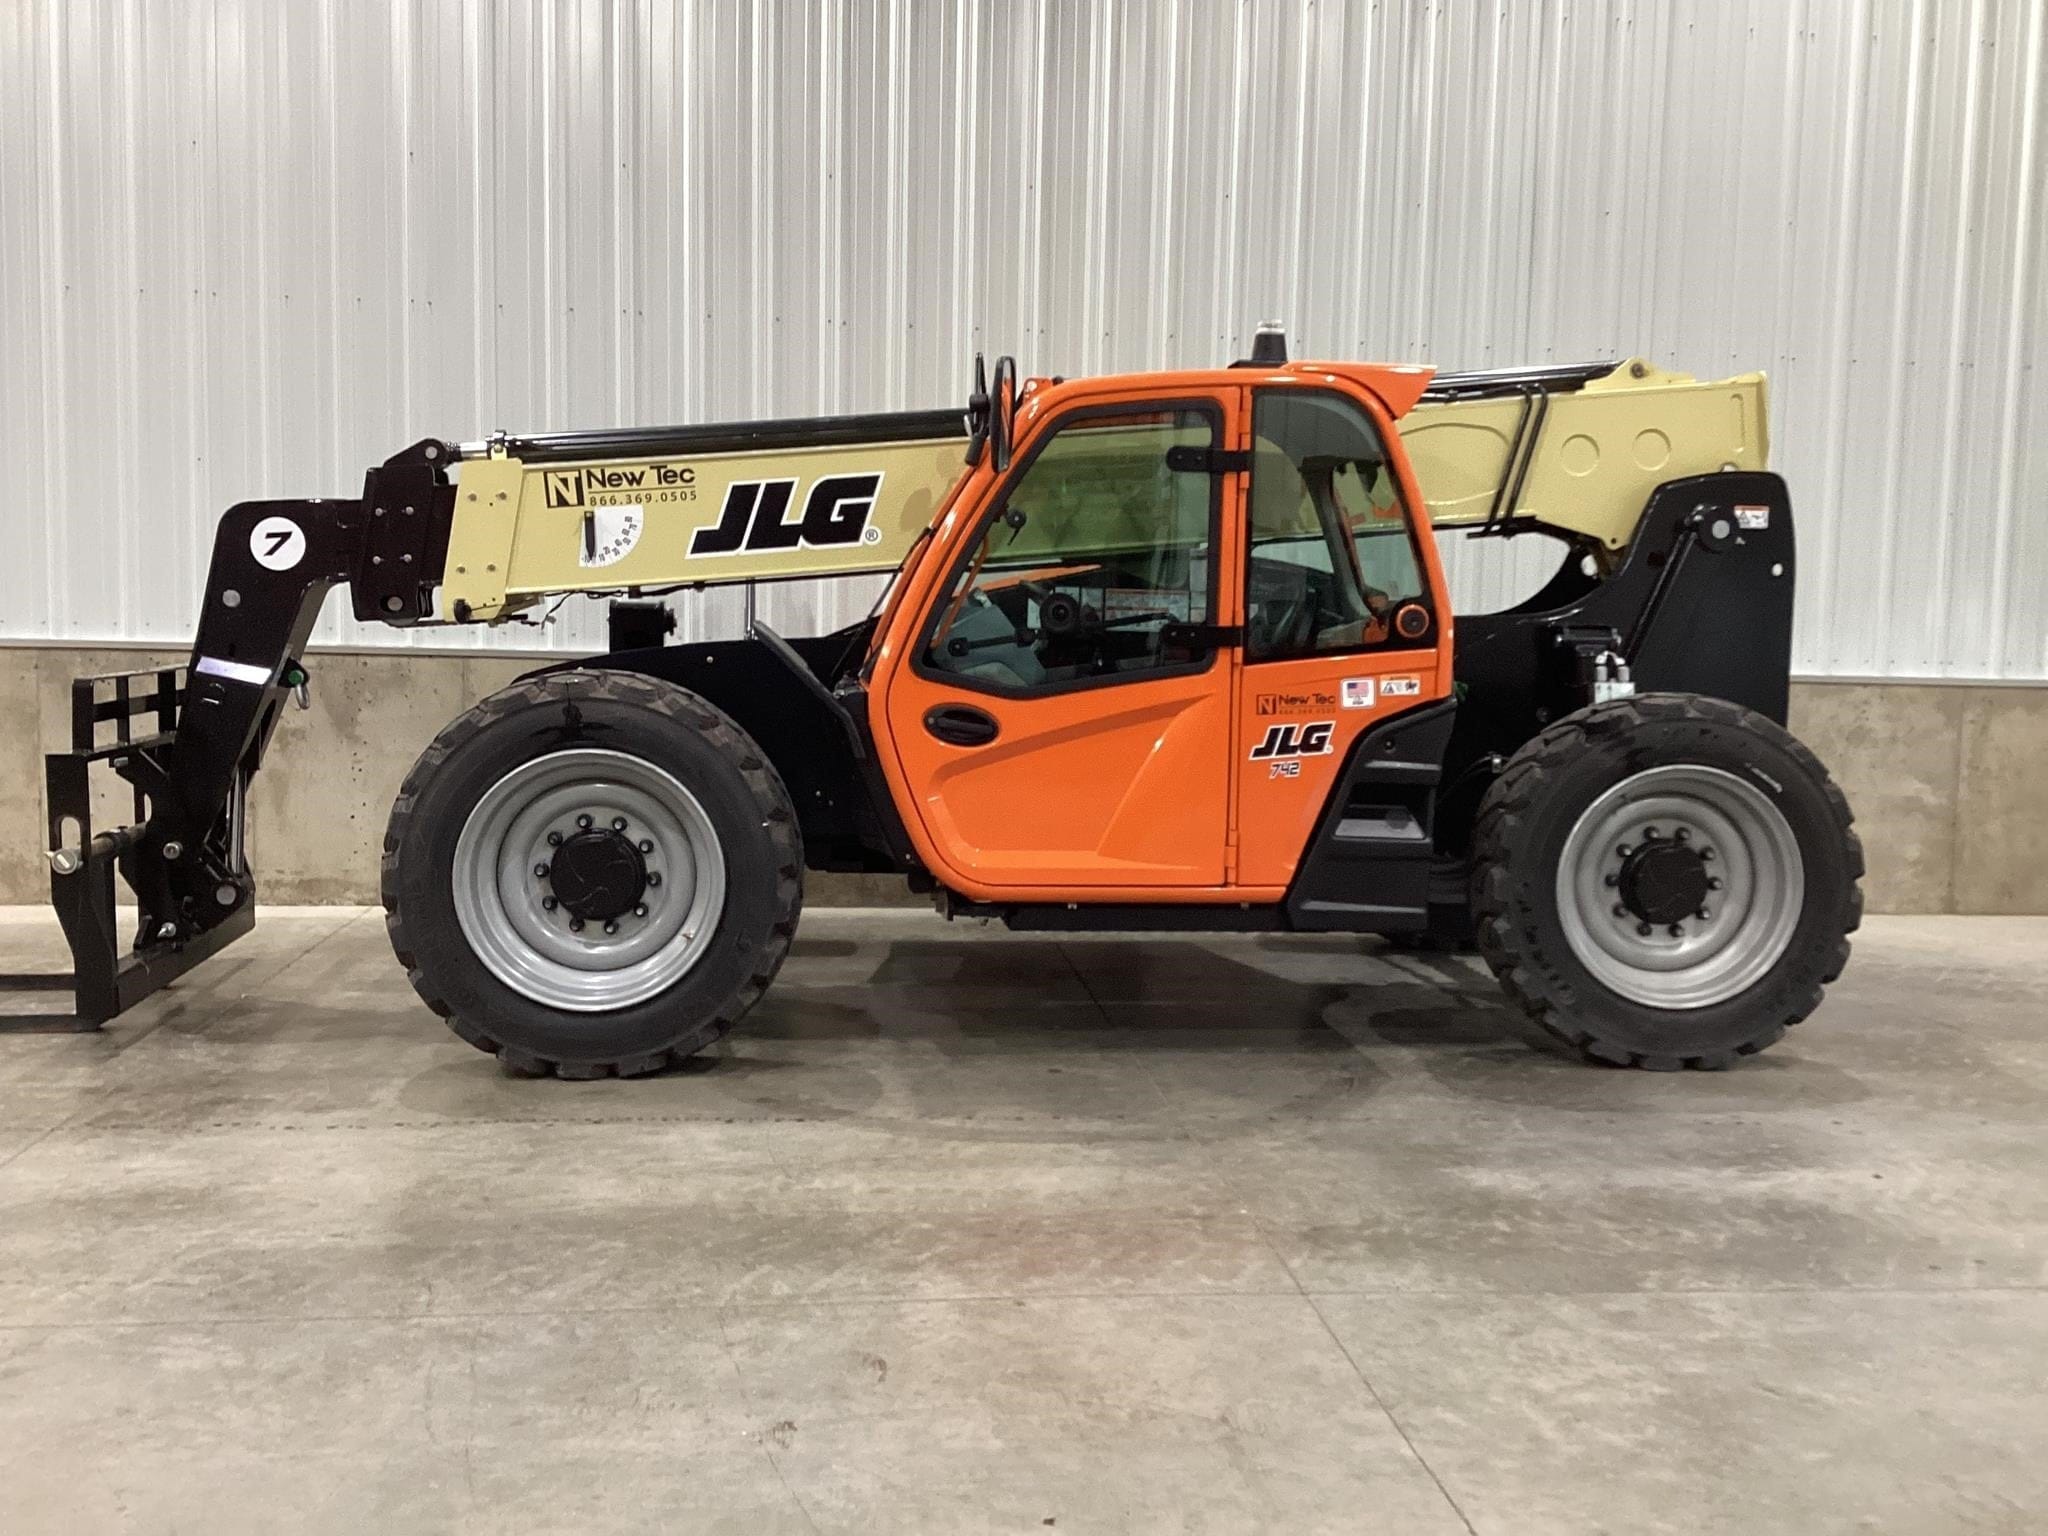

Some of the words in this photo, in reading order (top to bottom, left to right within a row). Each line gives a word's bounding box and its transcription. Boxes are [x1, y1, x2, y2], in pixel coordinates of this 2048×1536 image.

[586, 469, 645, 489] New
[650, 465, 696, 486] Tec
[590, 490, 697, 507] 866.369.0505
[689, 474, 881, 555] JLG
[263, 531, 293, 557] 7
[1279, 694, 1310, 706] New
[1312, 693, 1336, 705] Tec
[1251, 723, 1334, 758] JLG
[1271, 762, 1300, 776] 742
